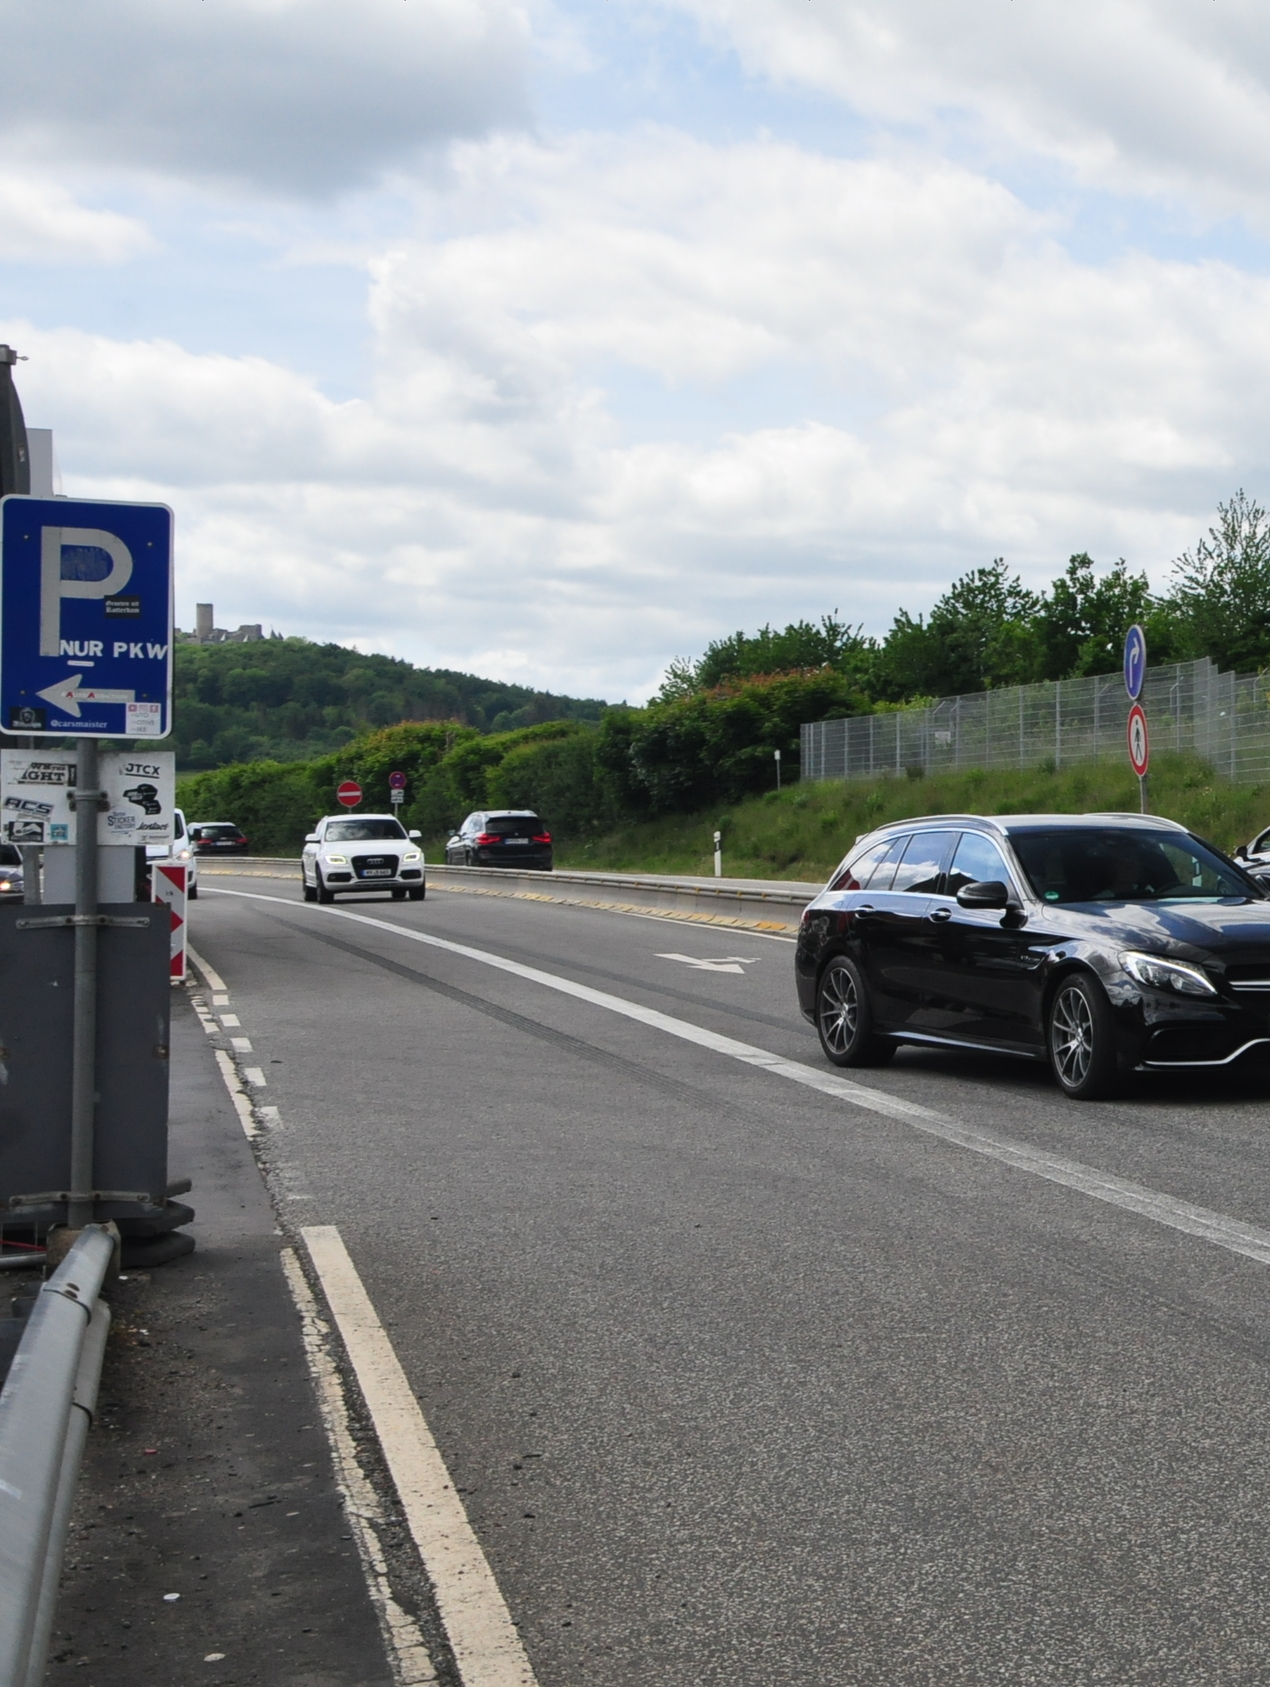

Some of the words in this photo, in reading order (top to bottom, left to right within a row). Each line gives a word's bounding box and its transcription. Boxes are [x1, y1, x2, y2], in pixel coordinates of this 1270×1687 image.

[39, 526, 133, 657] P
[59, 639, 104, 657] NUR
[113, 642, 169, 660] PKW
[125, 763, 161, 776] JTCX
[4, 797, 53, 814] ACS
